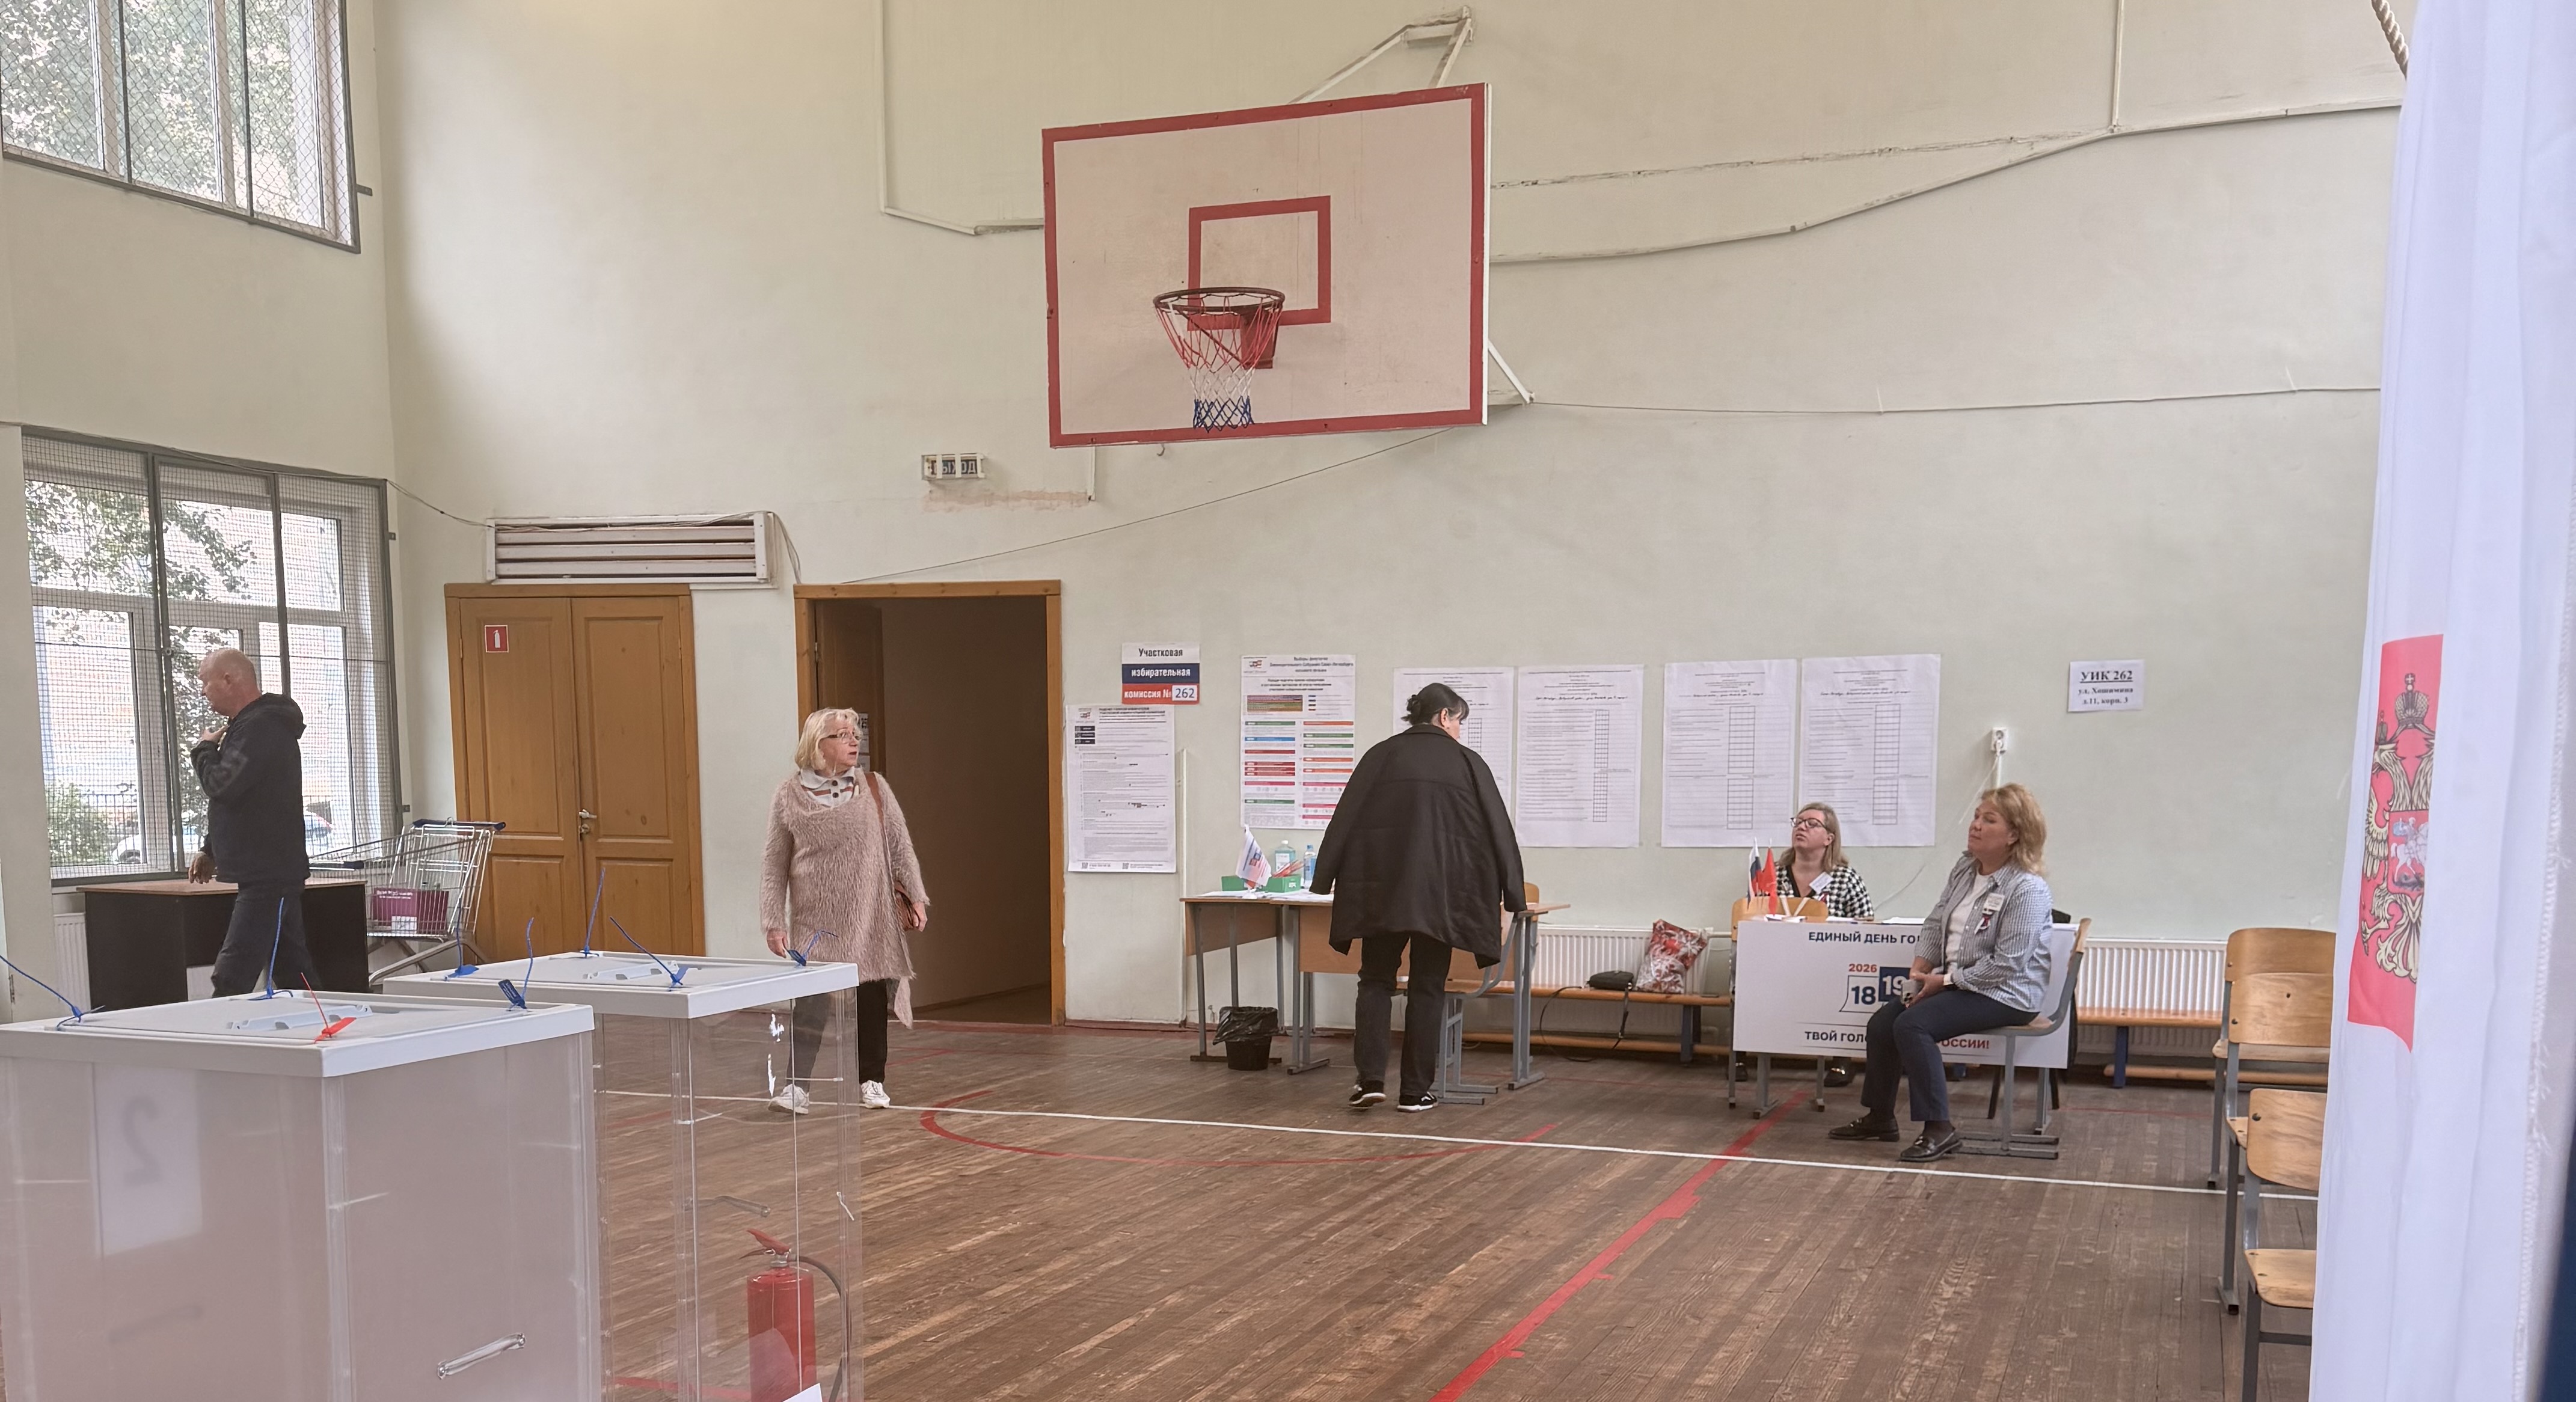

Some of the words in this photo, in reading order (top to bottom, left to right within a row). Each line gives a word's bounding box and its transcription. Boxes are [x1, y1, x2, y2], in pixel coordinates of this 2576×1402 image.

[1138, 648, 1183, 657] Участковая
[1131, 667, 1191, 678] избирательная
[2081, 670, 2111, 681] УИК
[2114, 670, 2133, 680] 262
[1175, 688, 1195, 698] 262
[1808, 931, 1861, 943] ЕДИНЫЙ
[1863, 934, 1897, 944] ДЕНЬ
[1900, 935, 1920, 944] ГО
[1848, 963, 1877, 973] 2026
[1882, 975, 1905, 996] 19
[1851, 985, 1876, 1005] 18
[1805, 1030, 1837, 1041] ТВОЙ
[1841, 1033, 1867, 1042] ГОЛ
[1940, 1038, 1989, 1049] ОССИИ!
